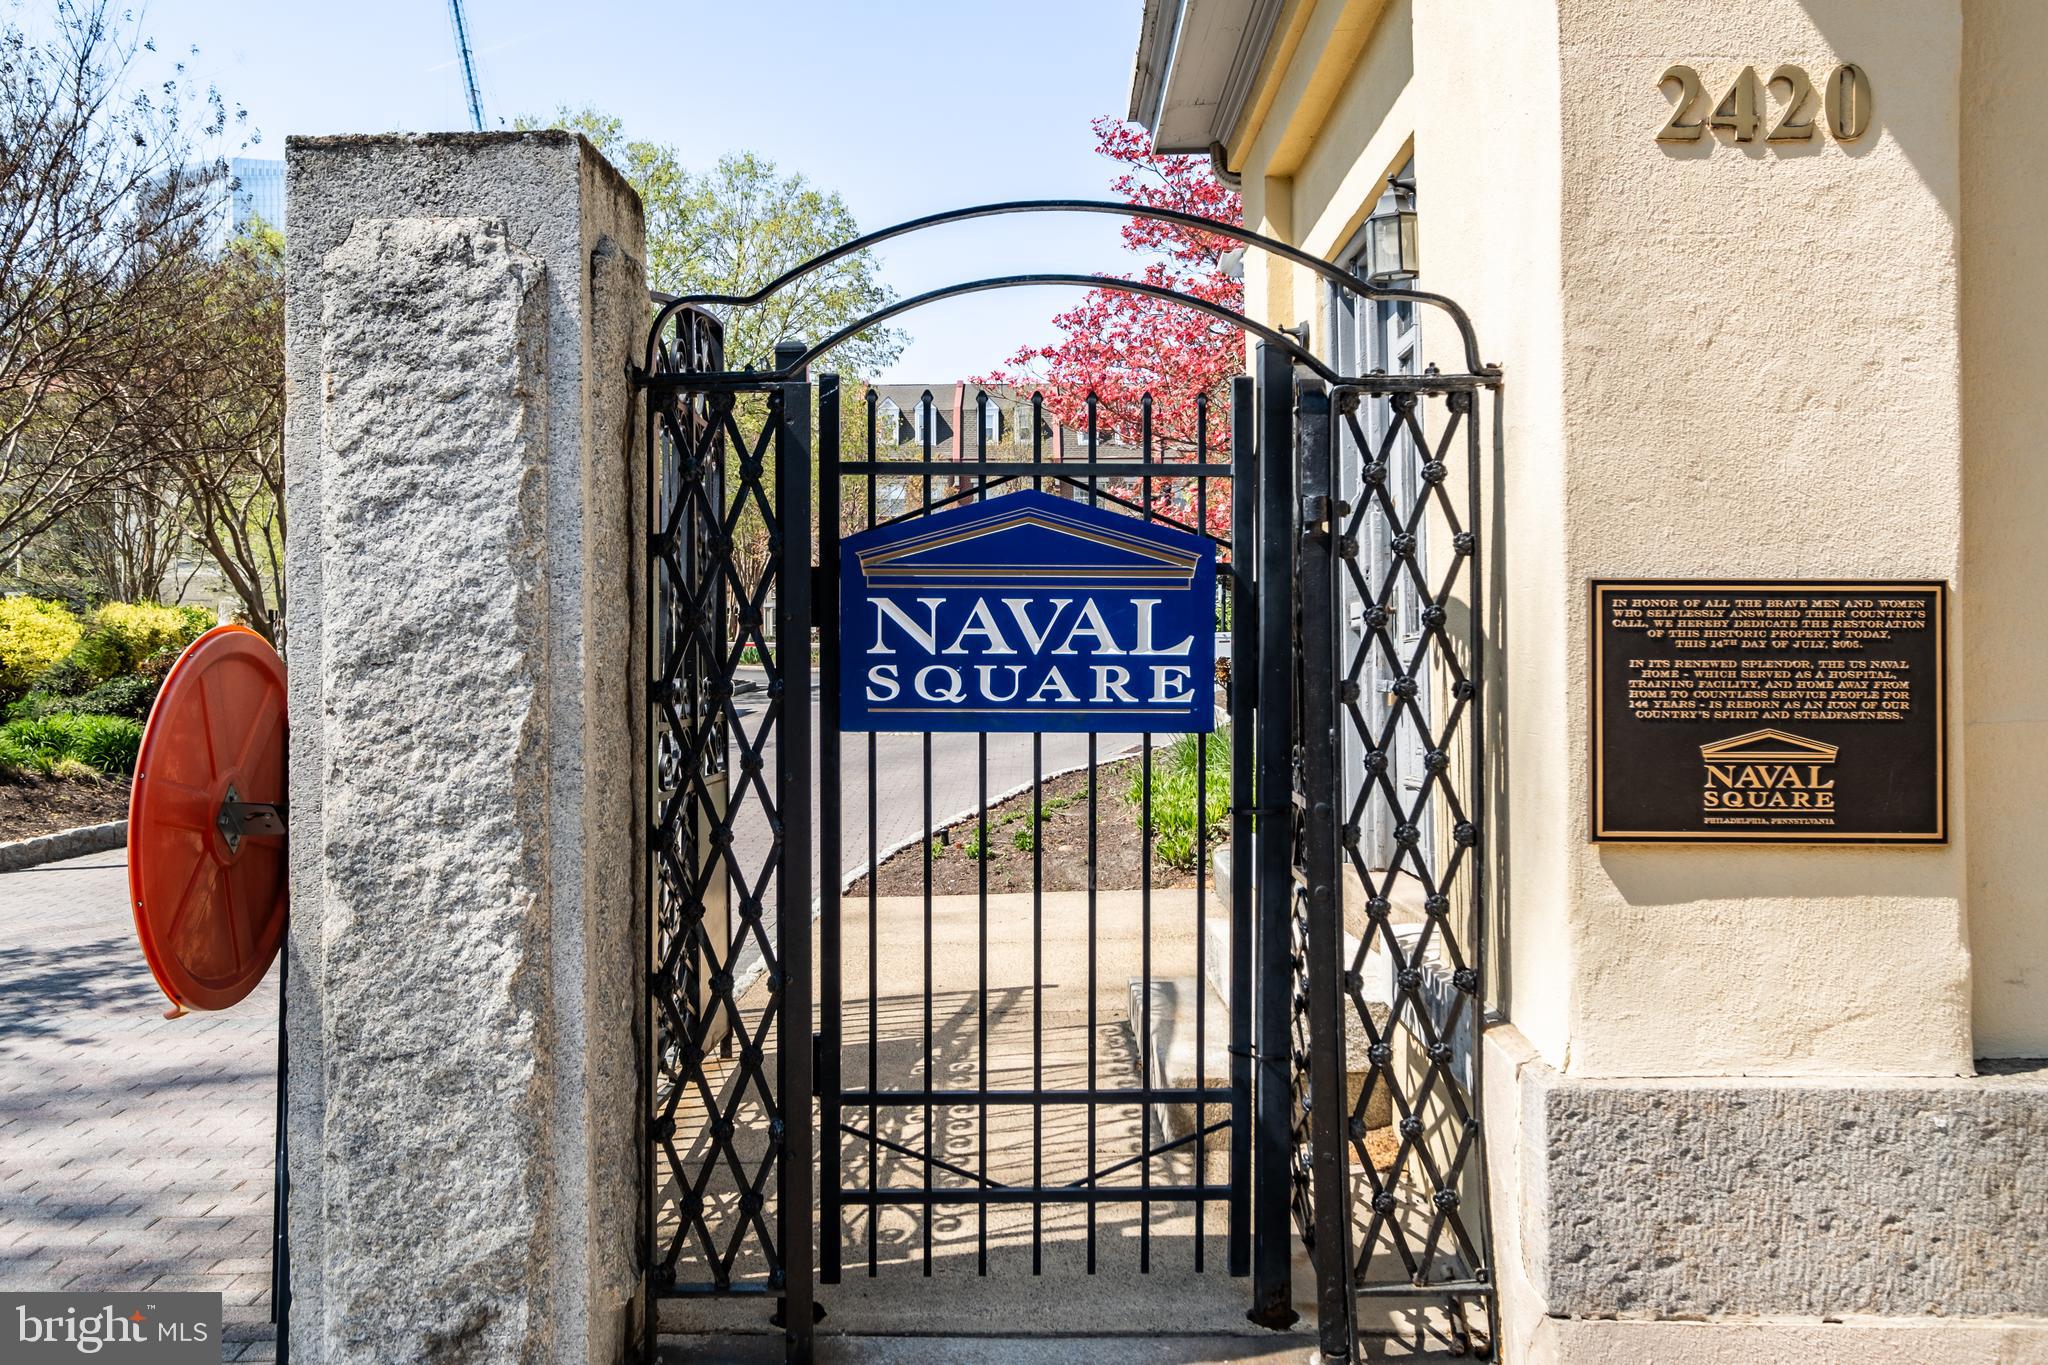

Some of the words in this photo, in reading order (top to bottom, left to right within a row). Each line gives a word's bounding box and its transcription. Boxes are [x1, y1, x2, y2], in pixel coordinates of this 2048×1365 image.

[1655, 63, 1872, 142] 2420
[1612, 599, 1627, 608] IN
[1632, 599, 1678, 608] HONOR
[1683, 599, 1700, 608] OF
[1705, 599, 1730, 608] ALL
[1735, 599, 1762, 608] THE
[1766, 599, 1808, 608] BRAVE
[1811, 599, 1840, 608] MEN
[1844, 599, 1873, 608] AND
[1878, 599, 1925, 608] WOMEN
[1613, 609, 1642, 618] WHO
[1647, 609, 1726, 618] SELFLESSLY
[1729, 609, 1801, 618] ANSWERED
[1805, 609, 1846, 618] THEIR
[1851, 609, 1926, 618] COUNTRY'S
[866, 597, 1195, 656] NAVAL
[1612, 619, 1649, 629] CALL,
[1653, 619, 1673, 628] WE
[1677, 619, 1730, 628] HEREBY
[1734, 619, 1798, 628] DEDICATE
[1802, 619, 1829, 628] THE
[1832, 619, 1925, 628] RESTORATION
[1647, 629, 1665, 638] OF
[1668, 629, 1700, 638] THIS
[1703, 629, 1767, 638] HISTORIC
[1770, 629, 1841, 638] PROPERTY
[1844, 629, 1891, 639] TODAY,
[1675, 639, 1707, 648] THIS
[1741, 639, 1767, 648] DAY
[1772, 639, 1789, 648] OF
[1793, 639, 1828, 649] JULY,
[1628, 660, 1644, 669] IN
[1648, 660, 1671, 669] ITS
[1674, 660, 1737, 669] RENEWED
[1741, 660, 1814, 670] SPLENDOR,
[1818, 660, 1845, 669] THE
[1849, 660, 1867, 669] US
[1870, 660, 1909, 669] NAVAL
[1641, 670, 1680, 679] HOME
[1693, 670, 1737, 679] WHICH
[1741, 670, 1791, 679] SERVED
[1795, 670, 1812, 679] AS
[1815, 670, 1825, 679] A
[1828, 670, 1897, 680] HOSPITAL,
[866, 664, 1195, 704] SQUARE
[1628, 680, 1694, 689] TRAINING
[1698, 680, 1761, 690] FACILITY,
[1765, 680, 1793, 689] AND
[1796, 680, 1834, 689] HOME
[1838, 680, 1869, 689] AWAY
[1873, 680, 1910, 689] FROM
[1628, 690, 1667, 699] HOME
[1671, 690, 1688, 699] TO
[1693, 690, 1769, 699] COUNTLESS
[1772, 690, 1827, 699] SERVICE
[1831, 690, 1880, 699] PEOPLE
[1883, 690, 1910, 699] FOR
[1653, 700, 1696, 709] YEARS
[1709, 700, 1722, 709] IS
[1726, 700, 1780, 709] REBORN
[1784, 700, 1801, 709] AS
[1804, 700, 1823, 709] AN
[1827, 700, 1857, 709] ICON
[1861, 700, 1878, 709] OF
[1882, 700, 1910, 709] OUR
[1635, 710, 1710, 719] COUNTRY'S
[1714, 710, 1759, 719] SPIRIT
[1762, 710, 1790, 719] AND
[1794, 710, 1904, 719] STEADFASTNESS.
[1703, 765, 1836, 789] NAVAL
[1703, 791, 1836, 807] SQUARE
